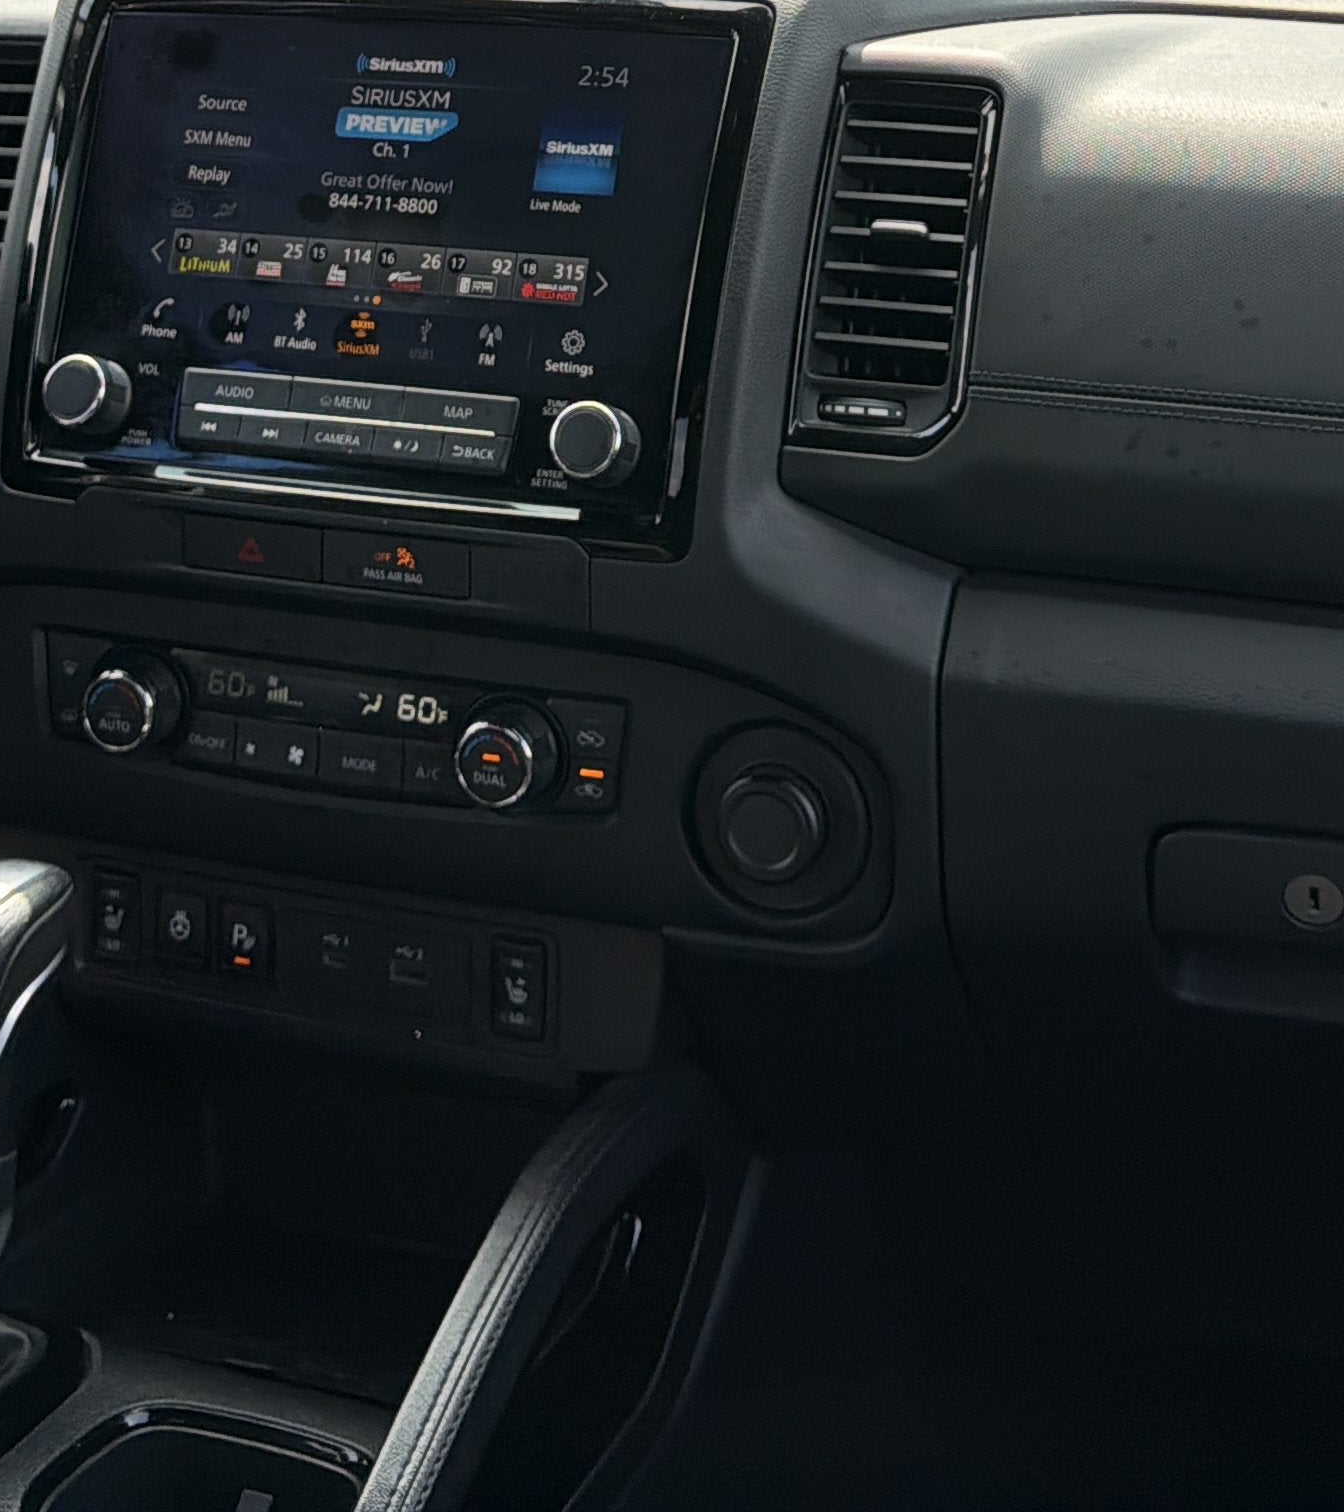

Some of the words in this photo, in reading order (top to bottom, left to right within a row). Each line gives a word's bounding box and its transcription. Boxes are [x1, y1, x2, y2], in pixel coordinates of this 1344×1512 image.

[577, 66, 630, 88] 2:54
[198, 95, 247, 112] Source
[351, 86, 451, 109] SIRIUSXM
[346, 114, 448, 136] PREVIEW
[184, 130, 212, 145] SXM
[216, 132, 252, 148] Menu
[372, 141, 396, 158] Ch.
[402, 144, 410, 158] 1
[546, 140, 614, 157] SiriusXM
[188, 164, 231, 185] Replay
[320, 171, 363, 189] Great
[366, 174, 408, 192] Offer
[411, 178, 454, 194] Now!
[328, 192, 438, 215] 844-711-8800
[530, 198, 550, 212] Live
[552, 200, 581, 214] Mode
[178, 235, 192, 250] 13
[217, 238, 237, 254] 34
[245, 242, 259, 254] 14
[284, 243, 303, 260] 25
[313, 247, 327, 259] 15
[344, 248, 371, 264] 114
[381, 252, 395, 264] 16
[420, 254, 442, 270] 26
[451, 258, 465, 270] 17
[492, 259, 513, 275] 92
[523, 263, 537, 275] 18
[553, 264, 585, 281] 315
[141, 324, 177, 339] Phone
[225, 332, 243, 344] AM
[274, 335, 287, 349] BT
[287, 337, 317, 350] Audio
[337, 342, 380, 356] SiriusXM
[478, 354, 496, 367] FM
[545, 359, 594, 377] Settings
[138, 363, 159, 376] VOL
[215, 385, 255, 399] AUDIO
[333, 395, 372, 410] MENU
[443, 406, 473, 420] MAP
[121, 436, 152, 446] POWER
[314, 431, 361, 447] CAMERA
[464, 448, 495, 460] BACK
[536, 469, 564, 479] ENTER
[531, 478, 568, 489] SETTING
[363, 567, 386, 580] PASS
[387, 570, 403, 582] AIR
[404, 572, 423, 585] BAG
[98, 718, 130, 733] AUTO
[342, 755, 379, 772] MODE
[415, 765, 442, 780] A/C
[473, 771, 507, 787] DUAL
